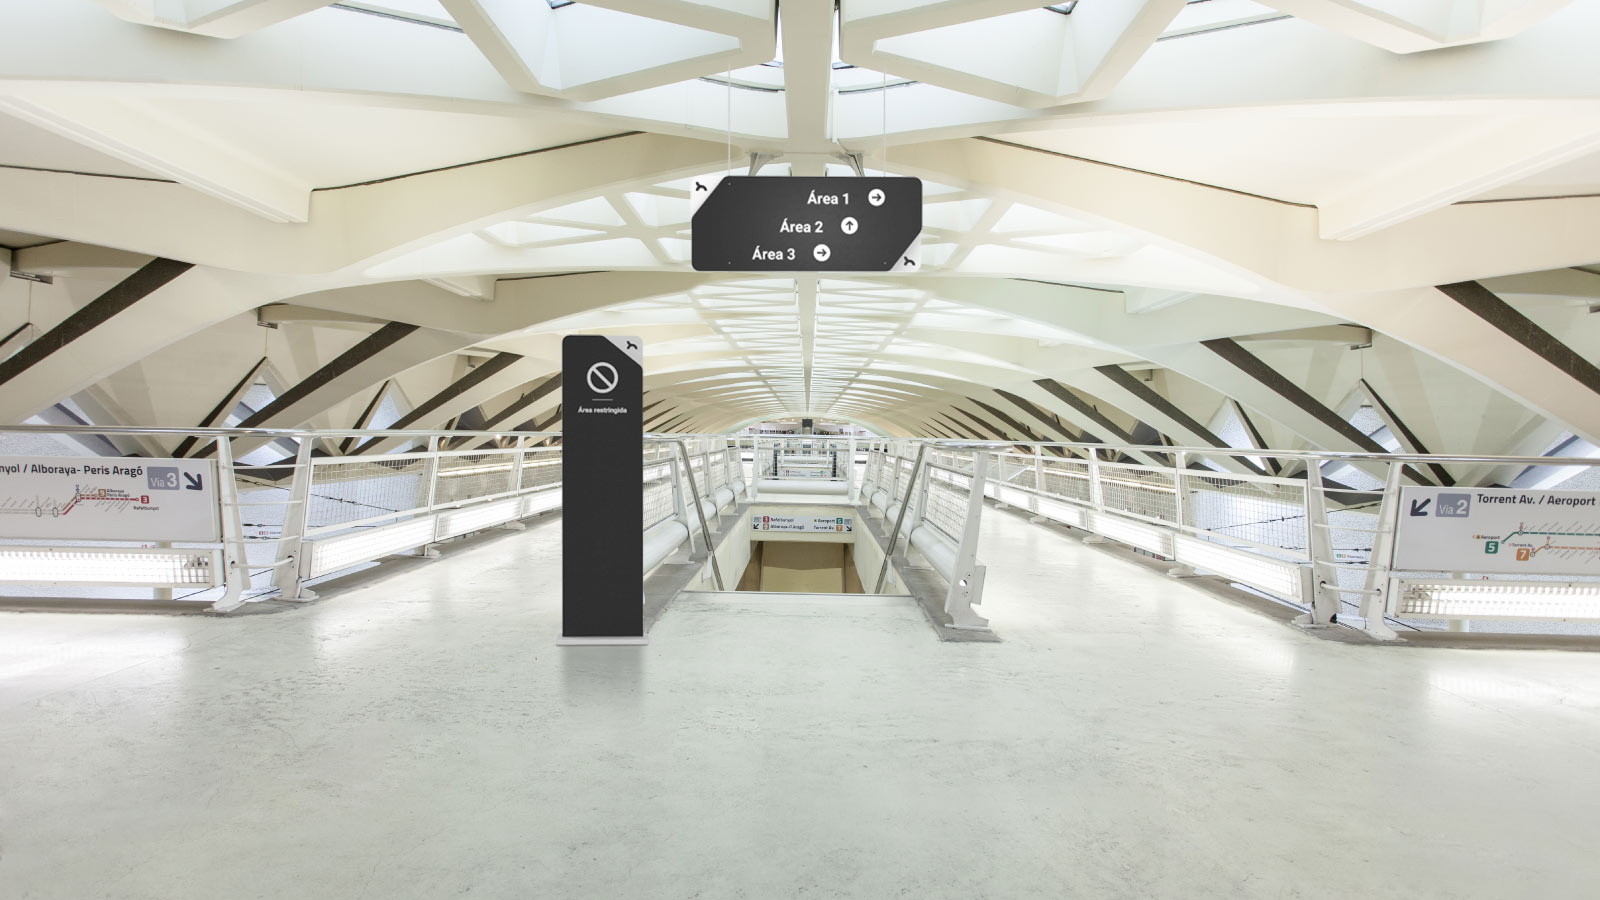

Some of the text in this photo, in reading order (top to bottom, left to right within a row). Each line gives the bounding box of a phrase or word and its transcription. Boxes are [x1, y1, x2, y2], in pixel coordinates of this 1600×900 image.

[807, 190, 850, 205] Área 1
[779, 218, 824, 233] Área 2
[752, 245, 796, 260] Área 3
[577, 405, 628, 415] Área restringida
[83, 465, 110, 475] Peris
[112, 465, 143, 478] Aragó
[166, 472, 177, 487] 3
[1456, 499, 1468, 515] 2
[1477, 493, 1517, 504] Torrent
[1519, 494, 1536, 504] Av.
[1546, 495, 1596, 508] Aeroport
[1487, 542, 1496, 552] 5
[1519, 550, 1527, 559] 7
